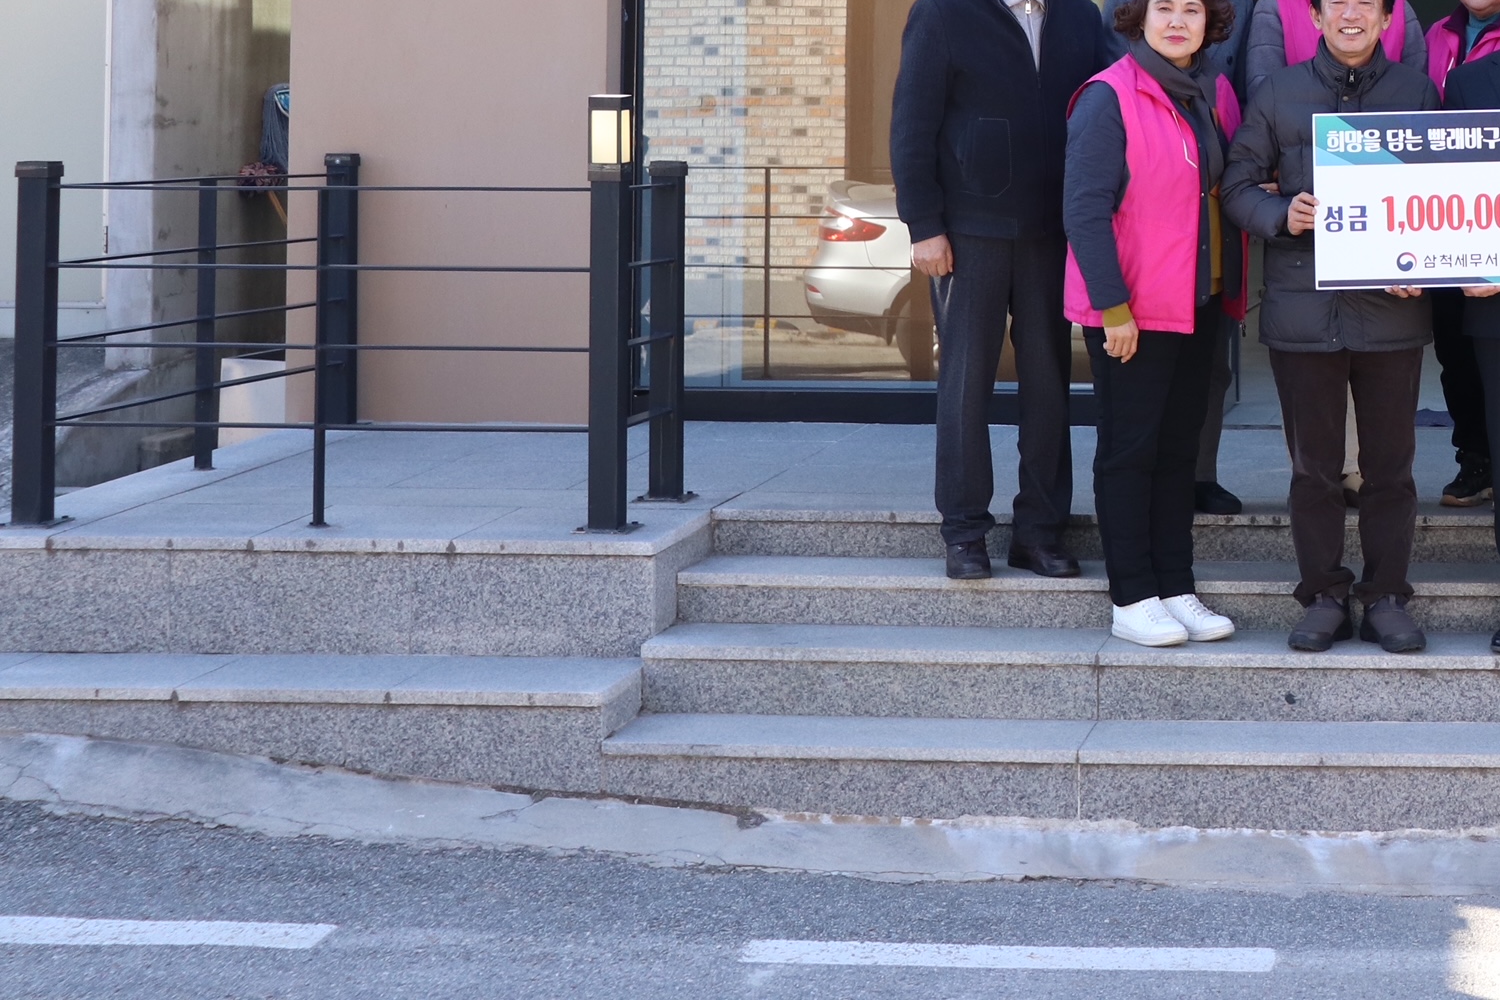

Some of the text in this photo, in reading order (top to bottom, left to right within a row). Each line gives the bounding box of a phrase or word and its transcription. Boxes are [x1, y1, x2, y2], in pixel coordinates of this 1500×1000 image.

[1325, 128, 1382, 153] 희망을
[1385, 127, 1424, 152] 담는
[1323, 204, 1369, 233] 성금
[1423, 252, 1499, 269] 삼척세무서
